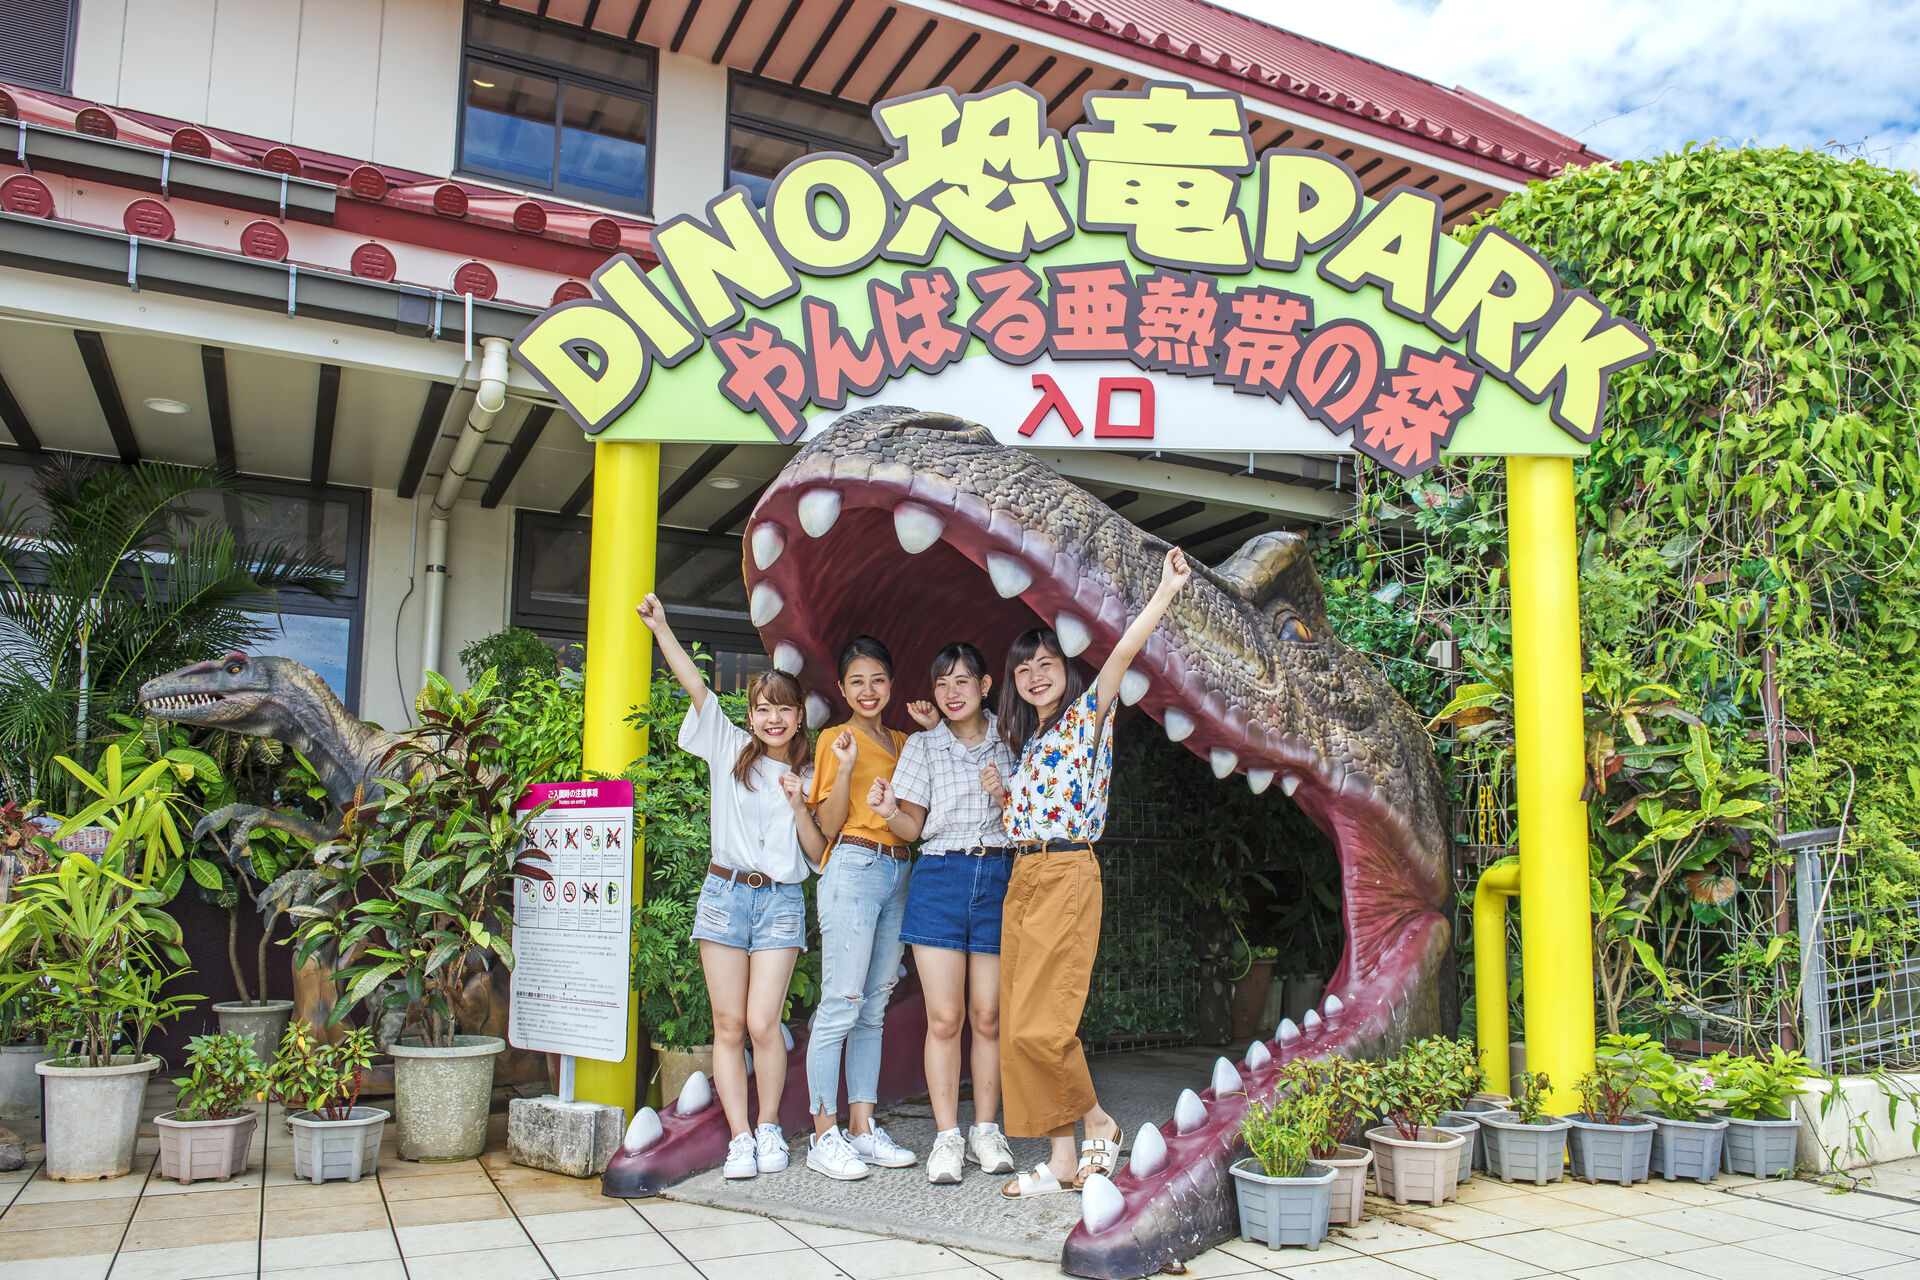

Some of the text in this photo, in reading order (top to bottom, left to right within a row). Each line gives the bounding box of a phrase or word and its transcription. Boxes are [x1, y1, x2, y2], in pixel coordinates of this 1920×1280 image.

[721, 266, 1477, 469] やんばる亜熱帯の森
[1018, 373, 1155, 439] 入口
